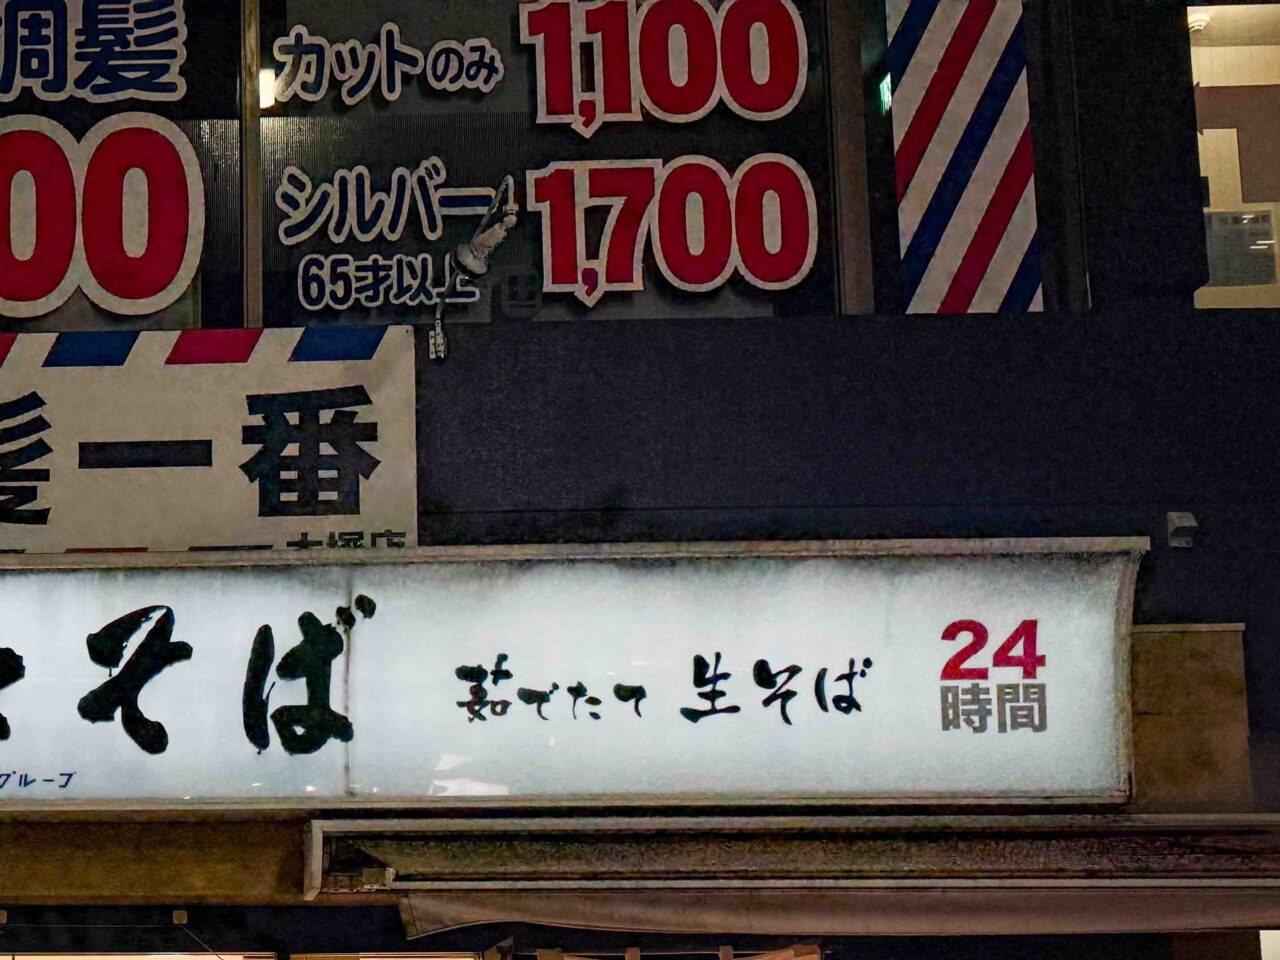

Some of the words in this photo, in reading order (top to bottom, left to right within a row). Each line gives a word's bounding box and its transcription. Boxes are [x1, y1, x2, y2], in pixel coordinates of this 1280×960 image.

[273, 22, 504, 105] カットのみ
[521, 0, 807, 138] 1,100
[275, 156, 500, 245] シルバー
[527, 153, 818, 307] 1,700
[298, 253, 480, 311] 65才以上
[680, 651, 874, 726] 生そば
[939, 619, 1046, 681] 24
[939, 683, 1047, 733] 時間
